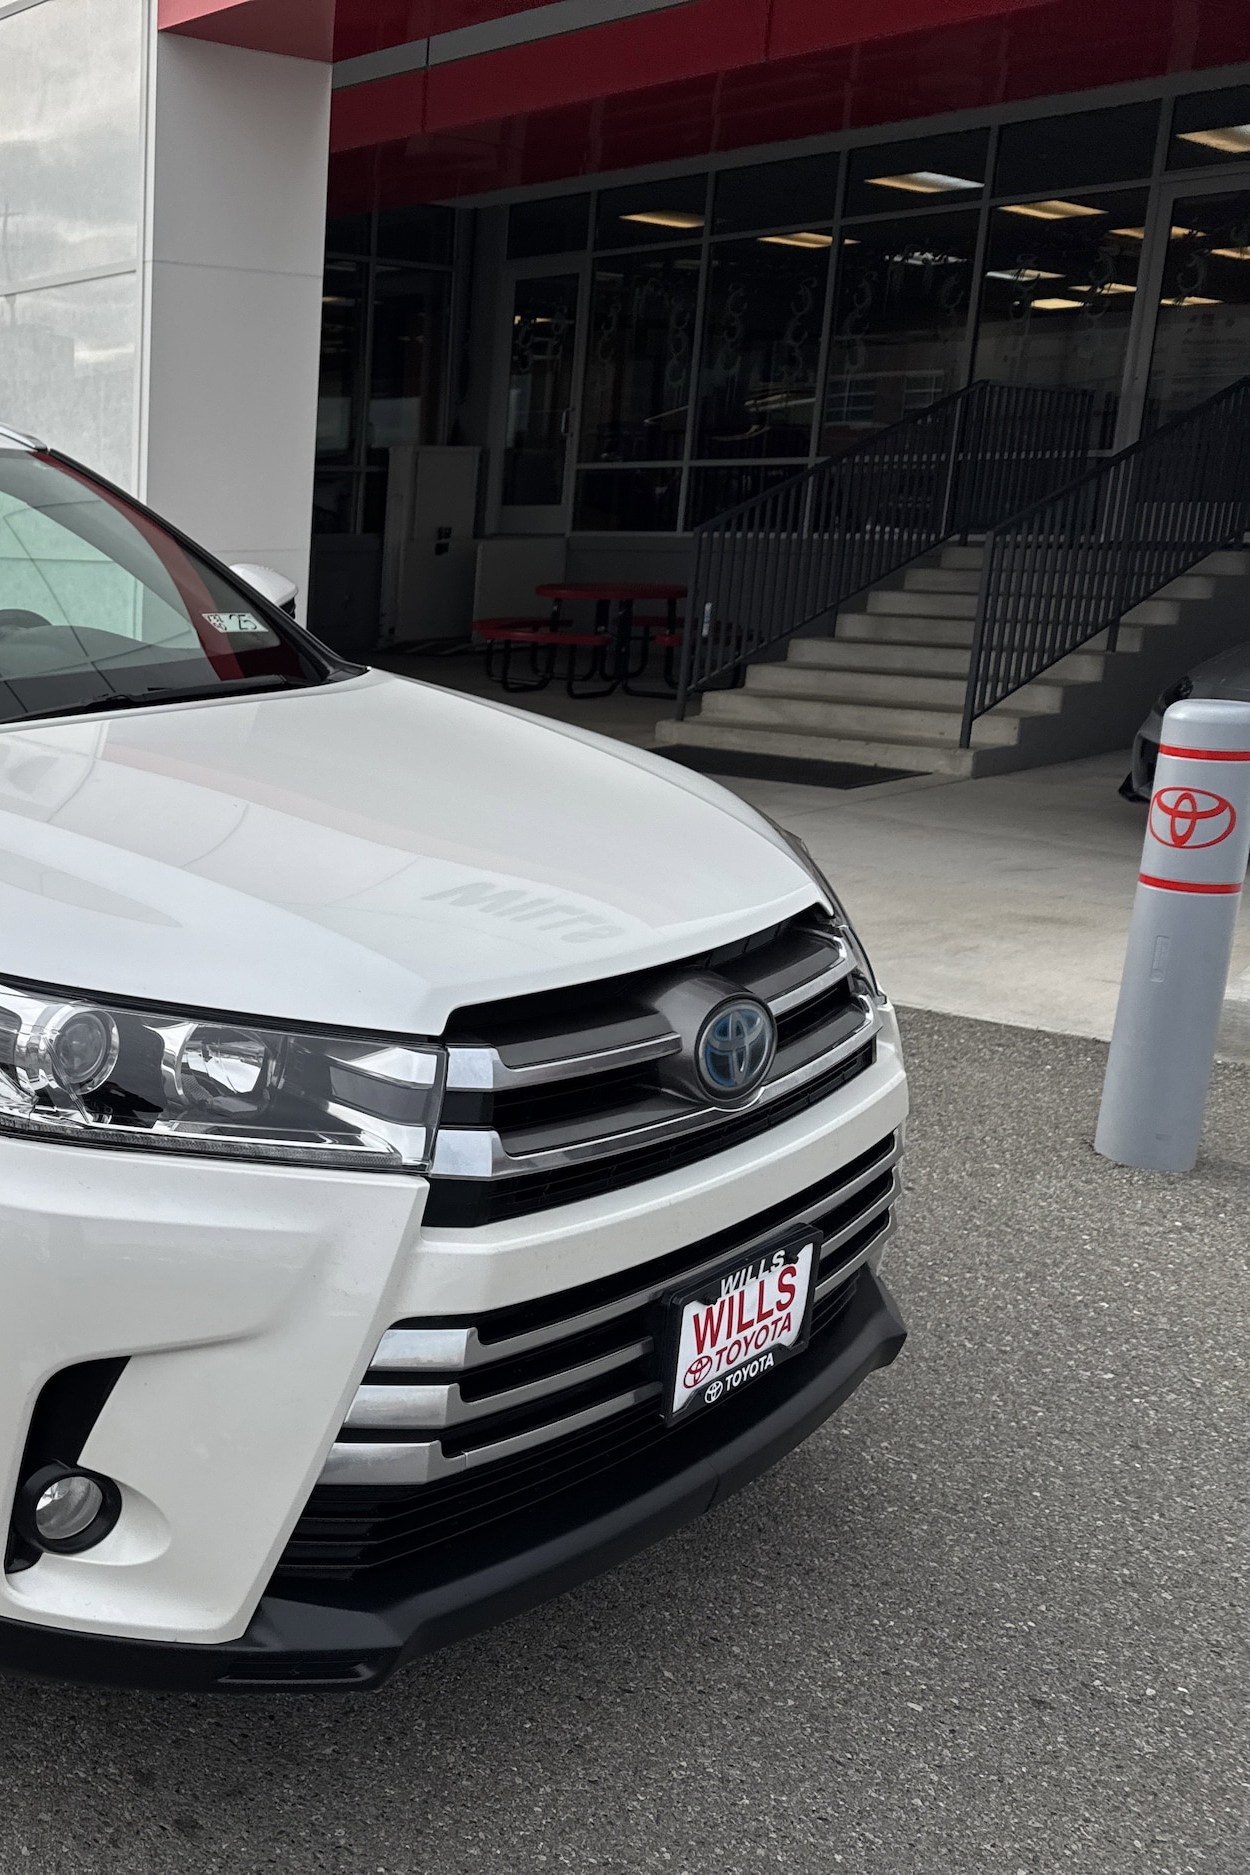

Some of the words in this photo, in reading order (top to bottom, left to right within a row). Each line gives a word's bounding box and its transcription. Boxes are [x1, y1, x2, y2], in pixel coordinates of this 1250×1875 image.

[720, 1250, 786, 1298] WILLS
[693, 1265, 797, 1355] WILLS
[715, 1312, 792, 1373] TOYOTA
[725, 1352, 775, 1391] TOYOTA
